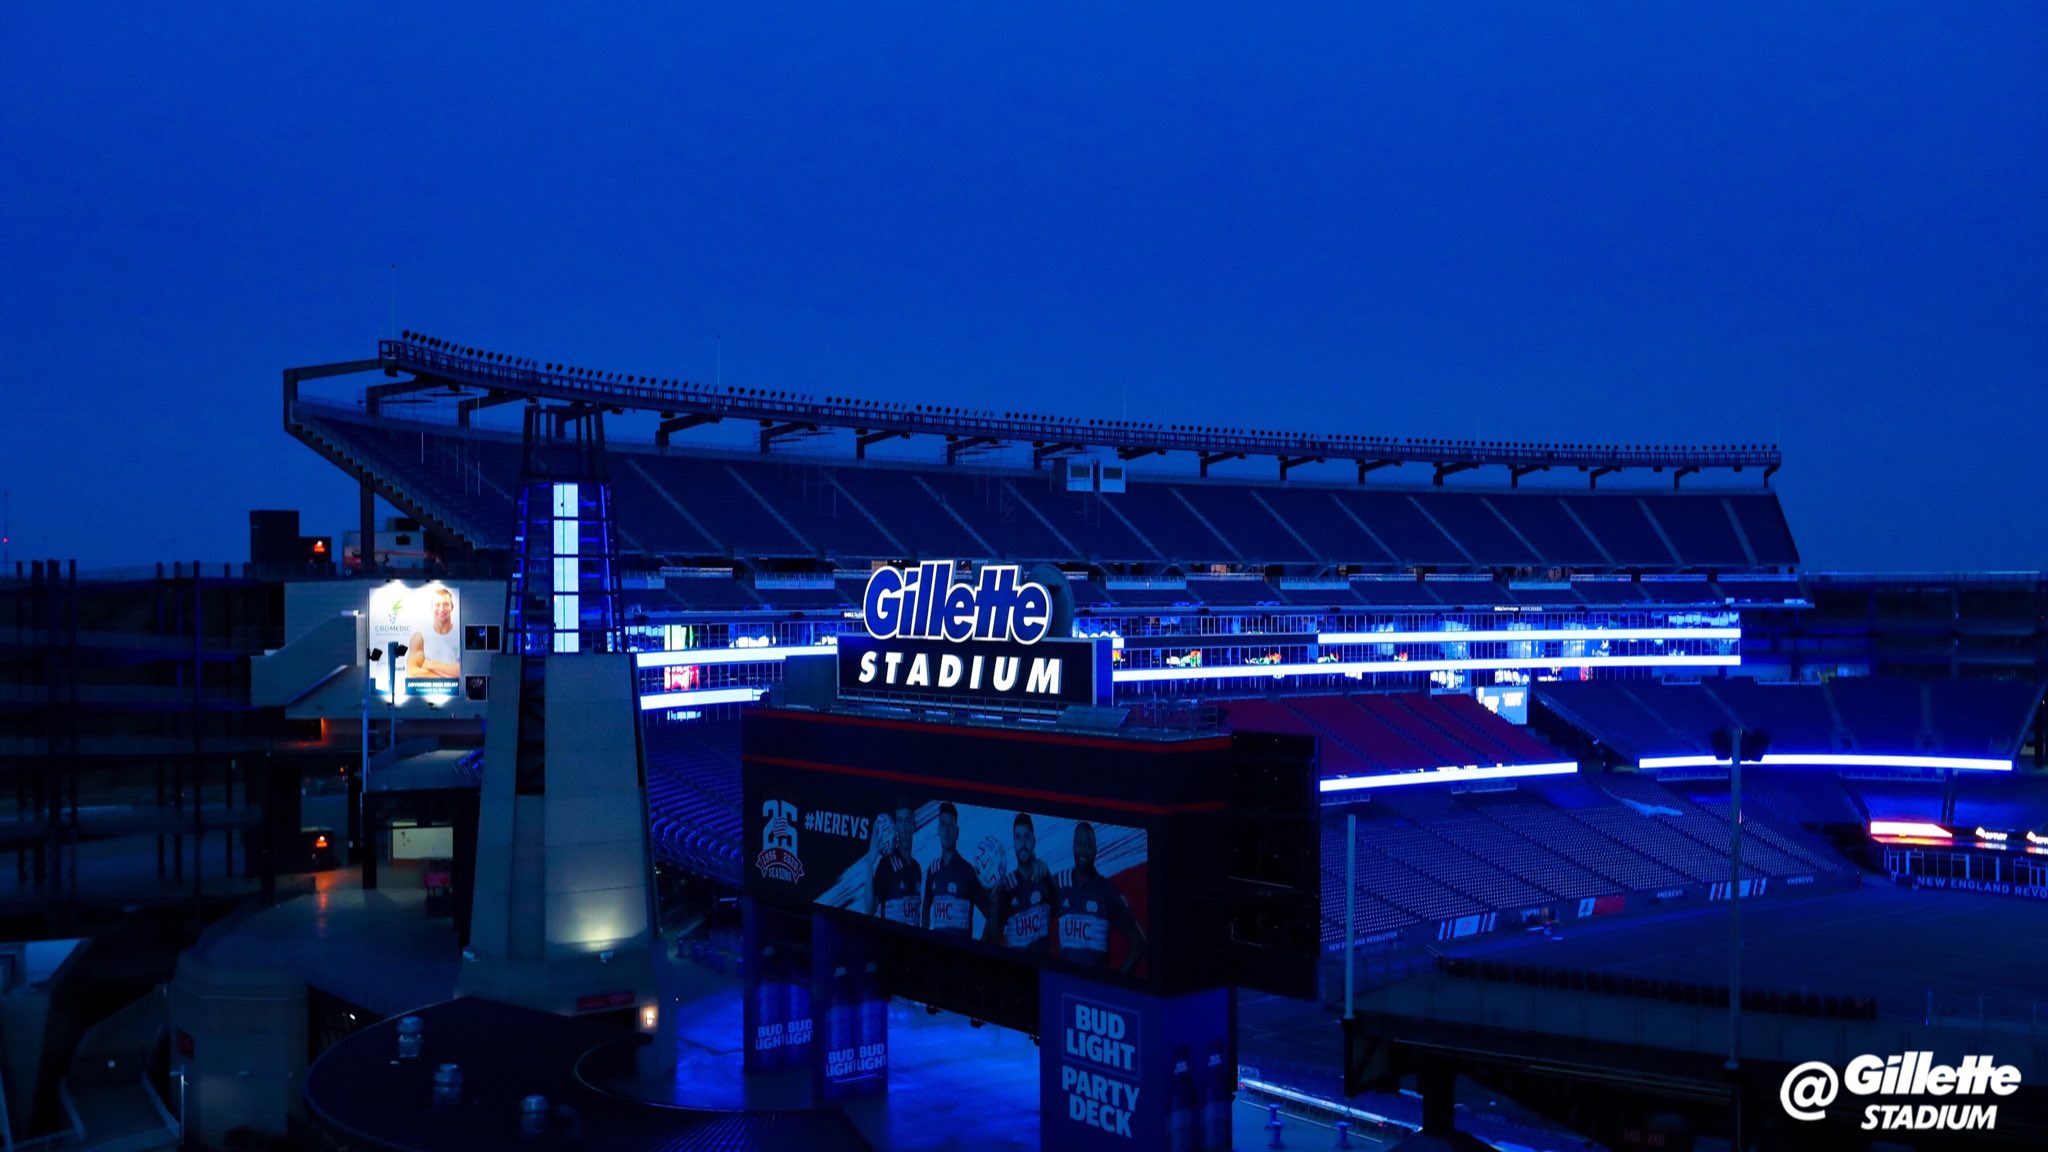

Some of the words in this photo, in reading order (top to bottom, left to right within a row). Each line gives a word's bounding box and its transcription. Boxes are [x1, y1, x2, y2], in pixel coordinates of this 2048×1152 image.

[863, 560, 1053, 645] Gillette
[858, 651, 1062, 694] STADIUM
[805, 810, 869, 840] #NEREVS
[783, 852, 799, 868] 2020
[768, 866, 792, 881] SEASONS
[1917, 876, 1946, 888] NEW
[1951, 879, 2010, 895] ENGLAND
[1015, 914, 1040, 936] UHC
[1064, 922, 1092, 942] UHC
[757, 1023, 783, 1038] BUD
[787, 1018, 813, 1033] BUD
[1075, 1003, 1125, 1041] BUD
[828, 1048, 855, 1064] BUD
[859, 1042, 885, 1058] BUD
[1066, 1028, 1135, 1071] LIGHT
[1062, 1065, 1140, 1112] PARTY
[1069, 1094, 1133, 1138] DECK
